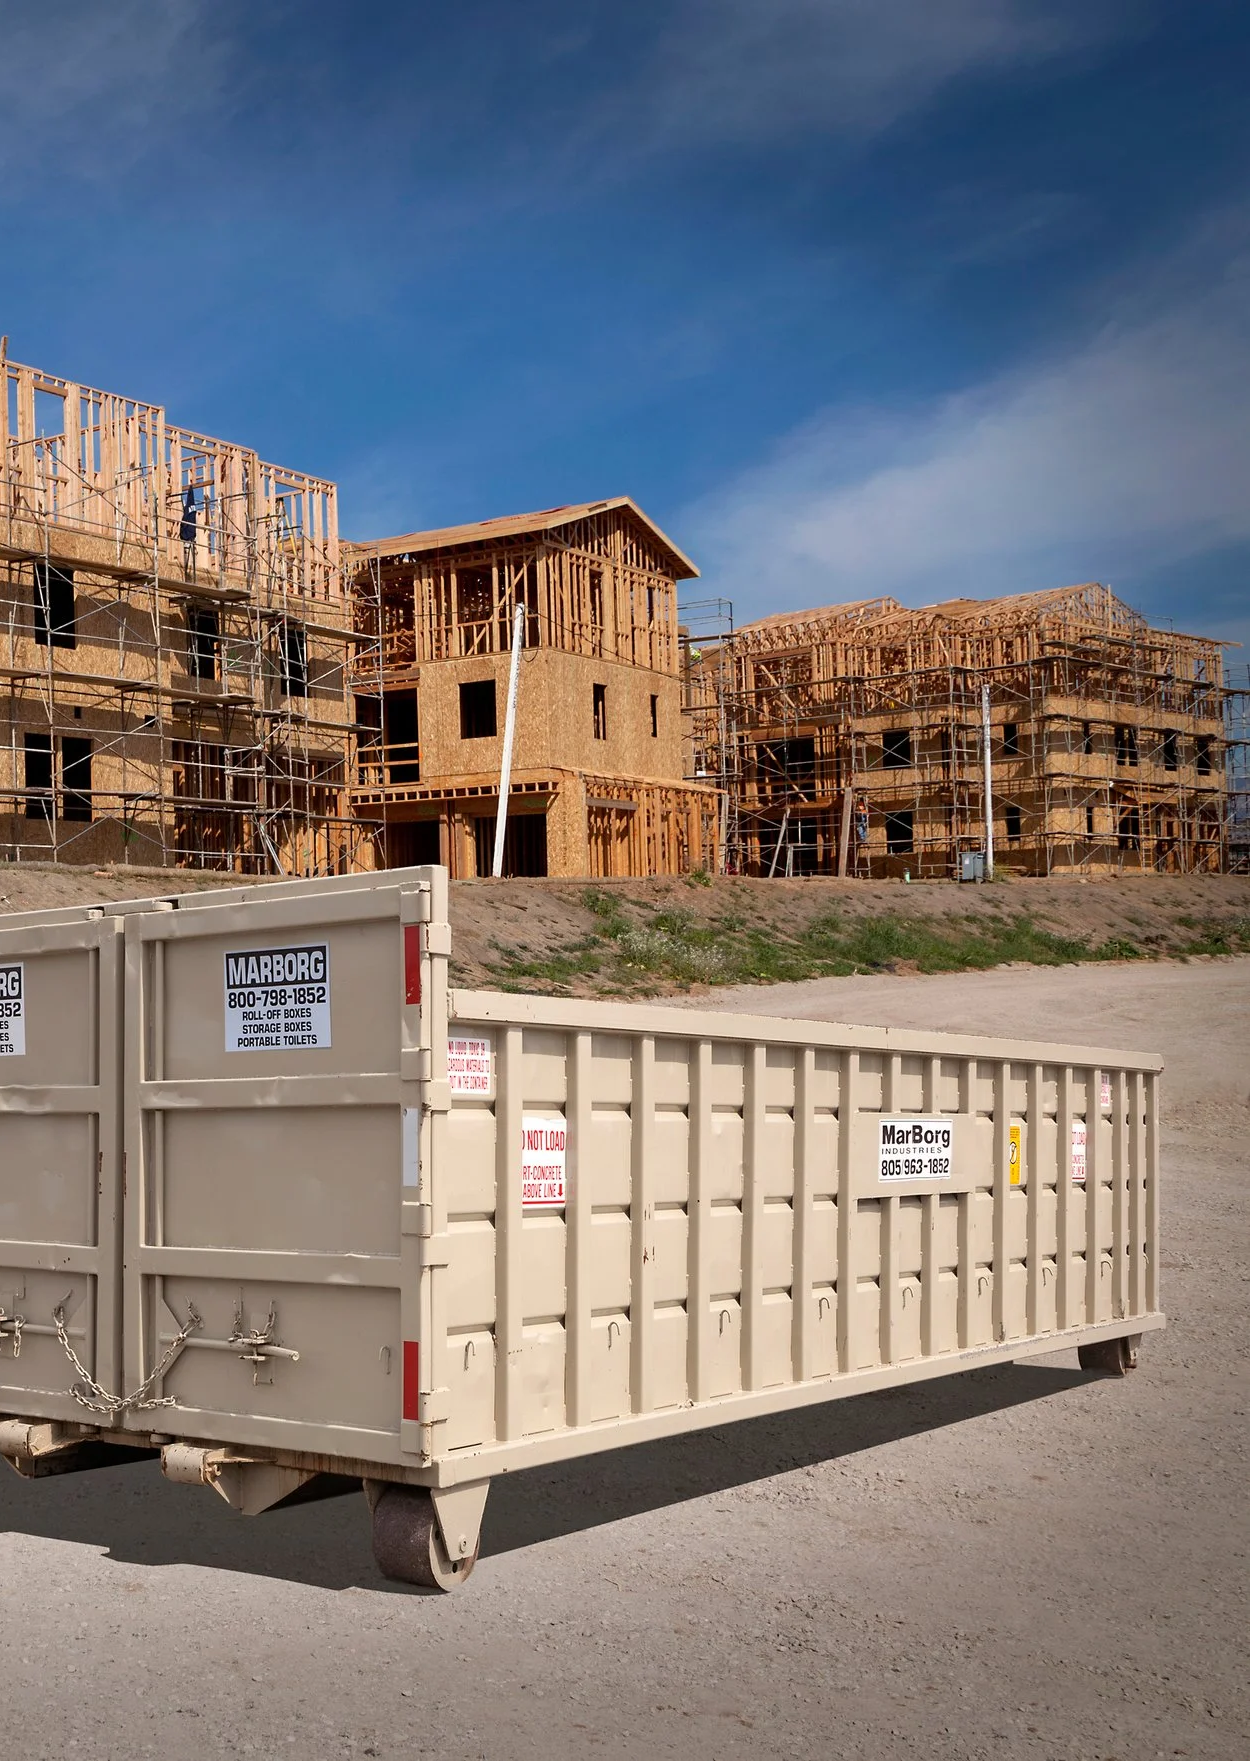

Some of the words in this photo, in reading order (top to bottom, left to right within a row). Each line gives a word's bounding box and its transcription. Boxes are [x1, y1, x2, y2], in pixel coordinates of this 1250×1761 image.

[228, 950, 324, 986] MARBORG
[228, 986, 326, 1009] 800-798-1852
[242, 1009, 282, 1021] ROLL-OFF
[284, 1007, 312, 1019] BOXES
[242, 1023, 282, 1034] STORAGE
[284, 1021, 312, 1032] BOXES
[237, 1036, 281, 1047] PORTABLE
[283, 1034, 317, 1045] TOILETS
[527, 1129, 544, 1151] NOT
[545, 1130, 565, 1151] LOAD
[882, 1124, 950, 1148] MarBorg
[881, 1147, 943, 1155] INDUSTRIES
[522, 1165, 562, 1180] RT-CONCRETE
[522, 1183, 542, 1198] ABOVE
[543, 1183, 557, 1198] LINE
